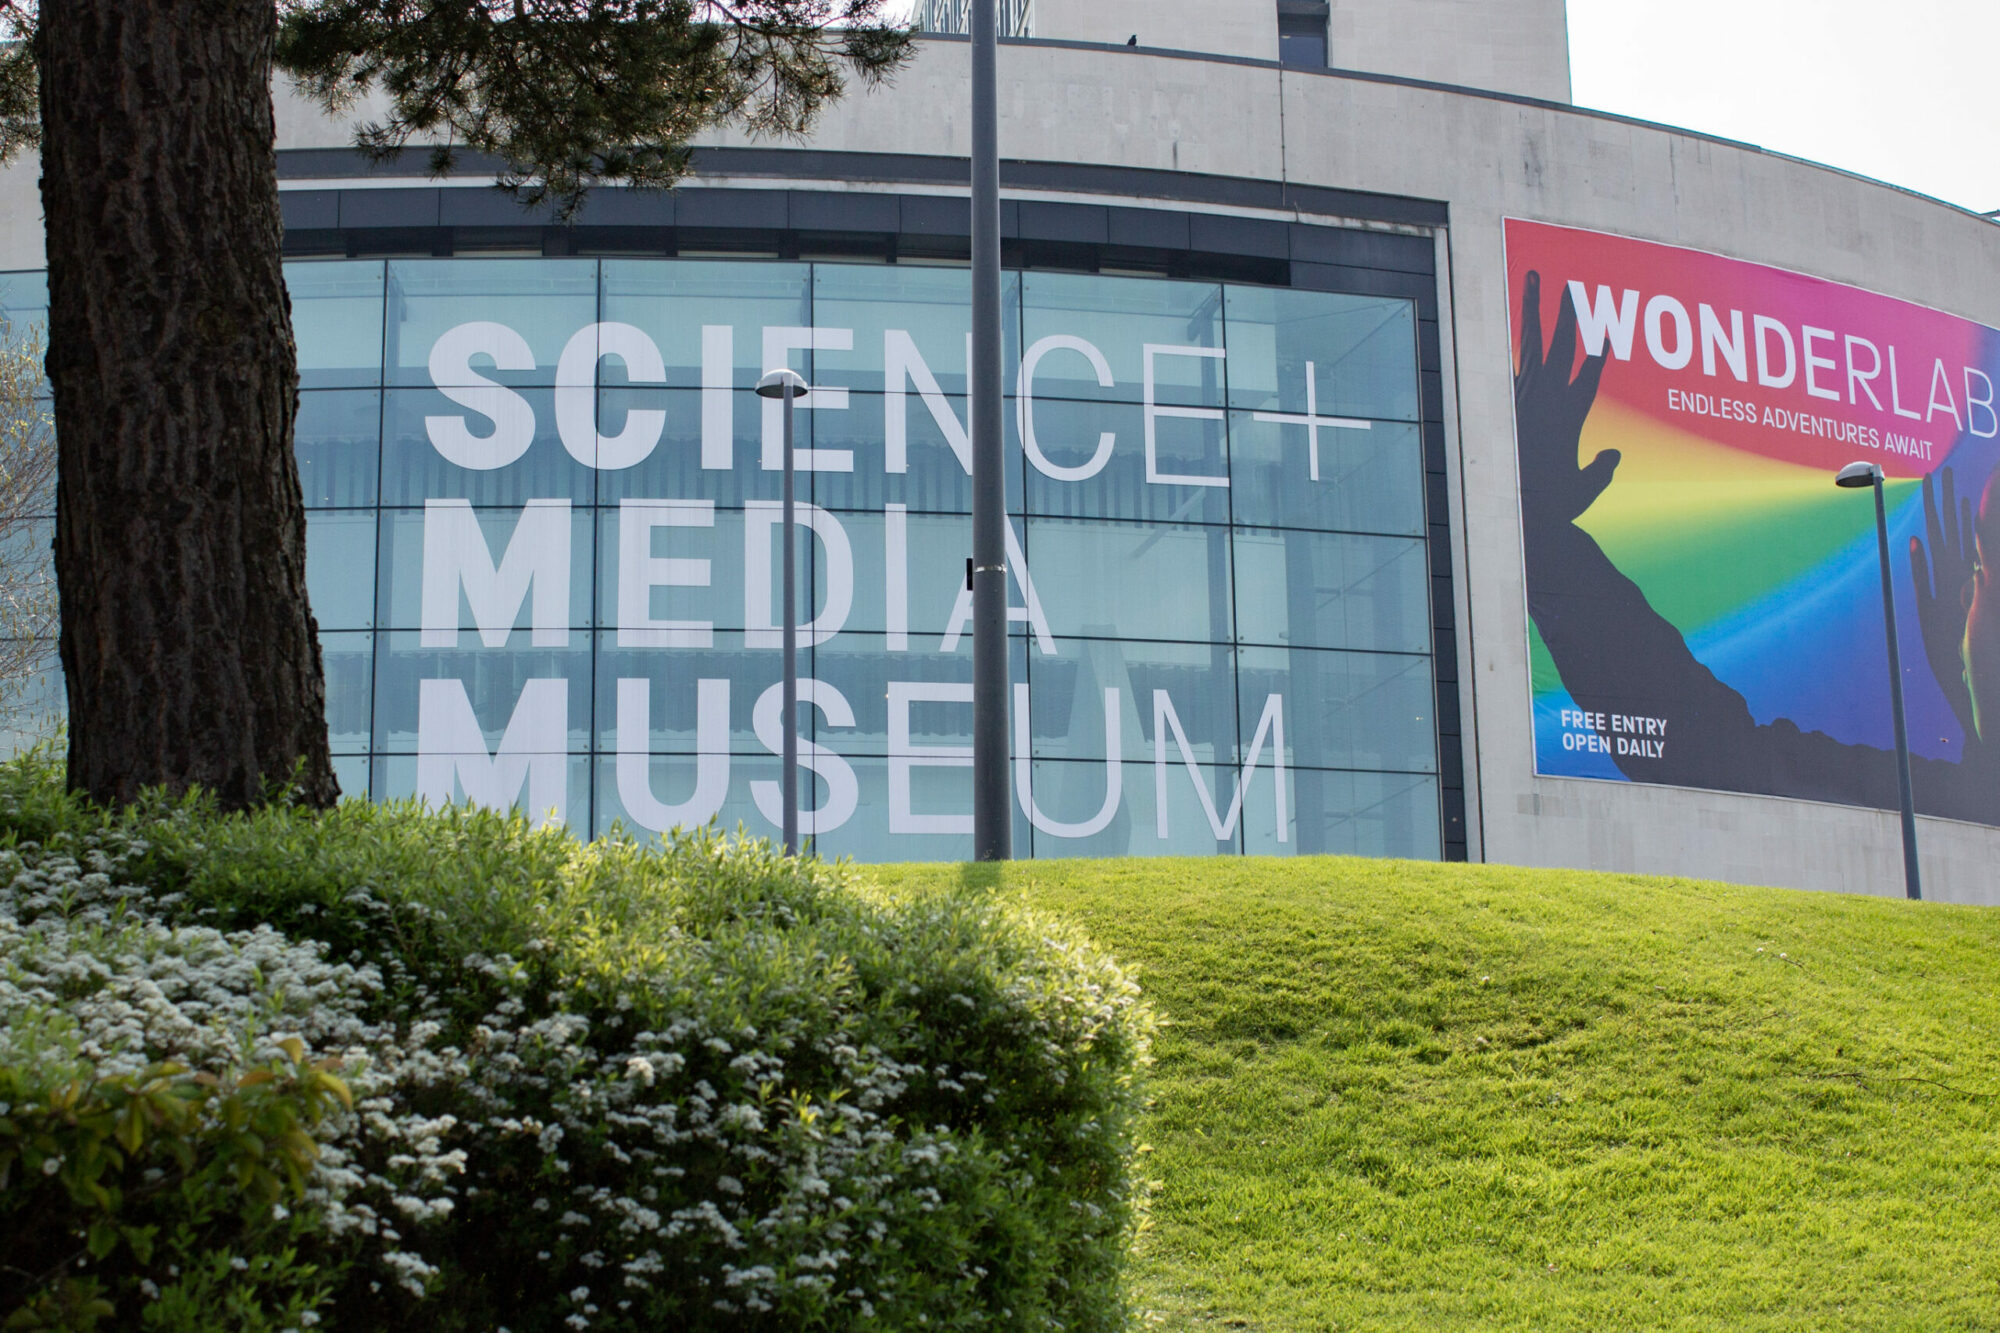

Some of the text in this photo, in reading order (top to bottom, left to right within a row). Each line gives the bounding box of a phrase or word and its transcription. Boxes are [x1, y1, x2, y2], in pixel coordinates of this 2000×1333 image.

[1567, 280, 1997, 438] WONDERLAB
[1668, 389, 1933, 461] ENDLESS ADVENTURES AWAIT
[420, 498, 1058, 655] MEDIA
[417, 677, 1288, 843] MUSEUM
[1561, 710, 1667, 736] FREE ENTRY
[1562, 732, 1665, 758] OPEN DAILY
